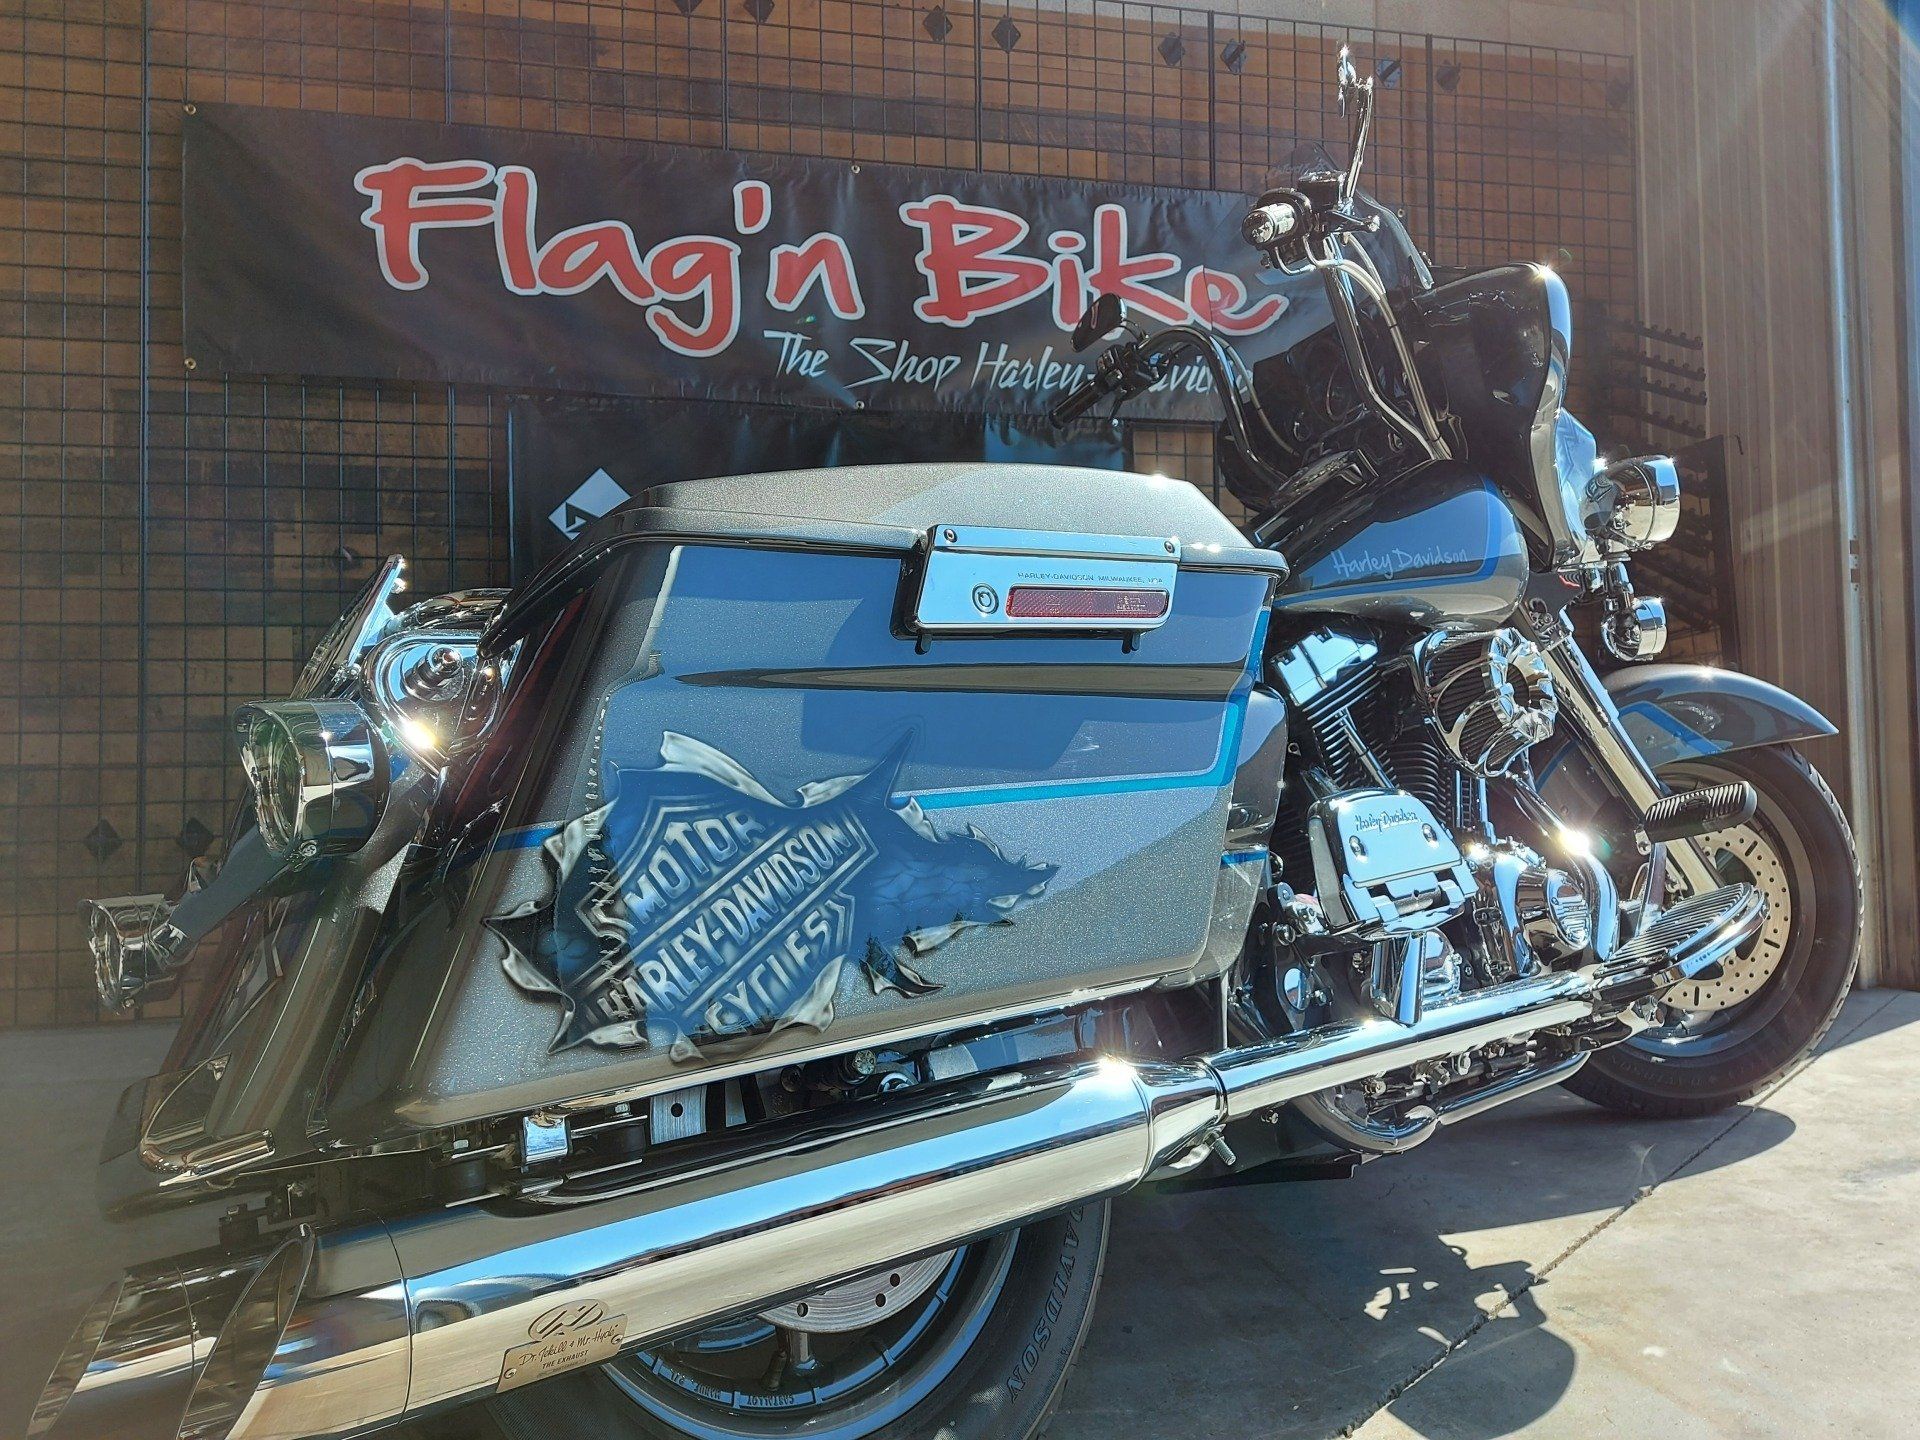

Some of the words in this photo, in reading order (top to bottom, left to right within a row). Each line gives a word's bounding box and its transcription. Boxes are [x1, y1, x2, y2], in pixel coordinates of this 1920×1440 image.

[354, 157, 865, 358] Flag'n
[900, 194, 1290, 341] Bike
[763, 330, 830, 378] The
[843, 337, 962, 392] Shop
[1017, 571, 1094, 581] HARLEY-DAVIDSON
[1331, 549, 1394, 579] Harley
[1392, 545, 1468, 573] Davidson
[623, 808, 766, 925] MOTOR
[588, 812, 853, 1022] HARLEY-DAVIDSON
[518, 1352, 537, 1366] Dr.
[577, 1335, 591, 1348] Mr.
[542, 1360, 555, 1370] THE
[557, 1349, 590, 1365] EXHAUST
